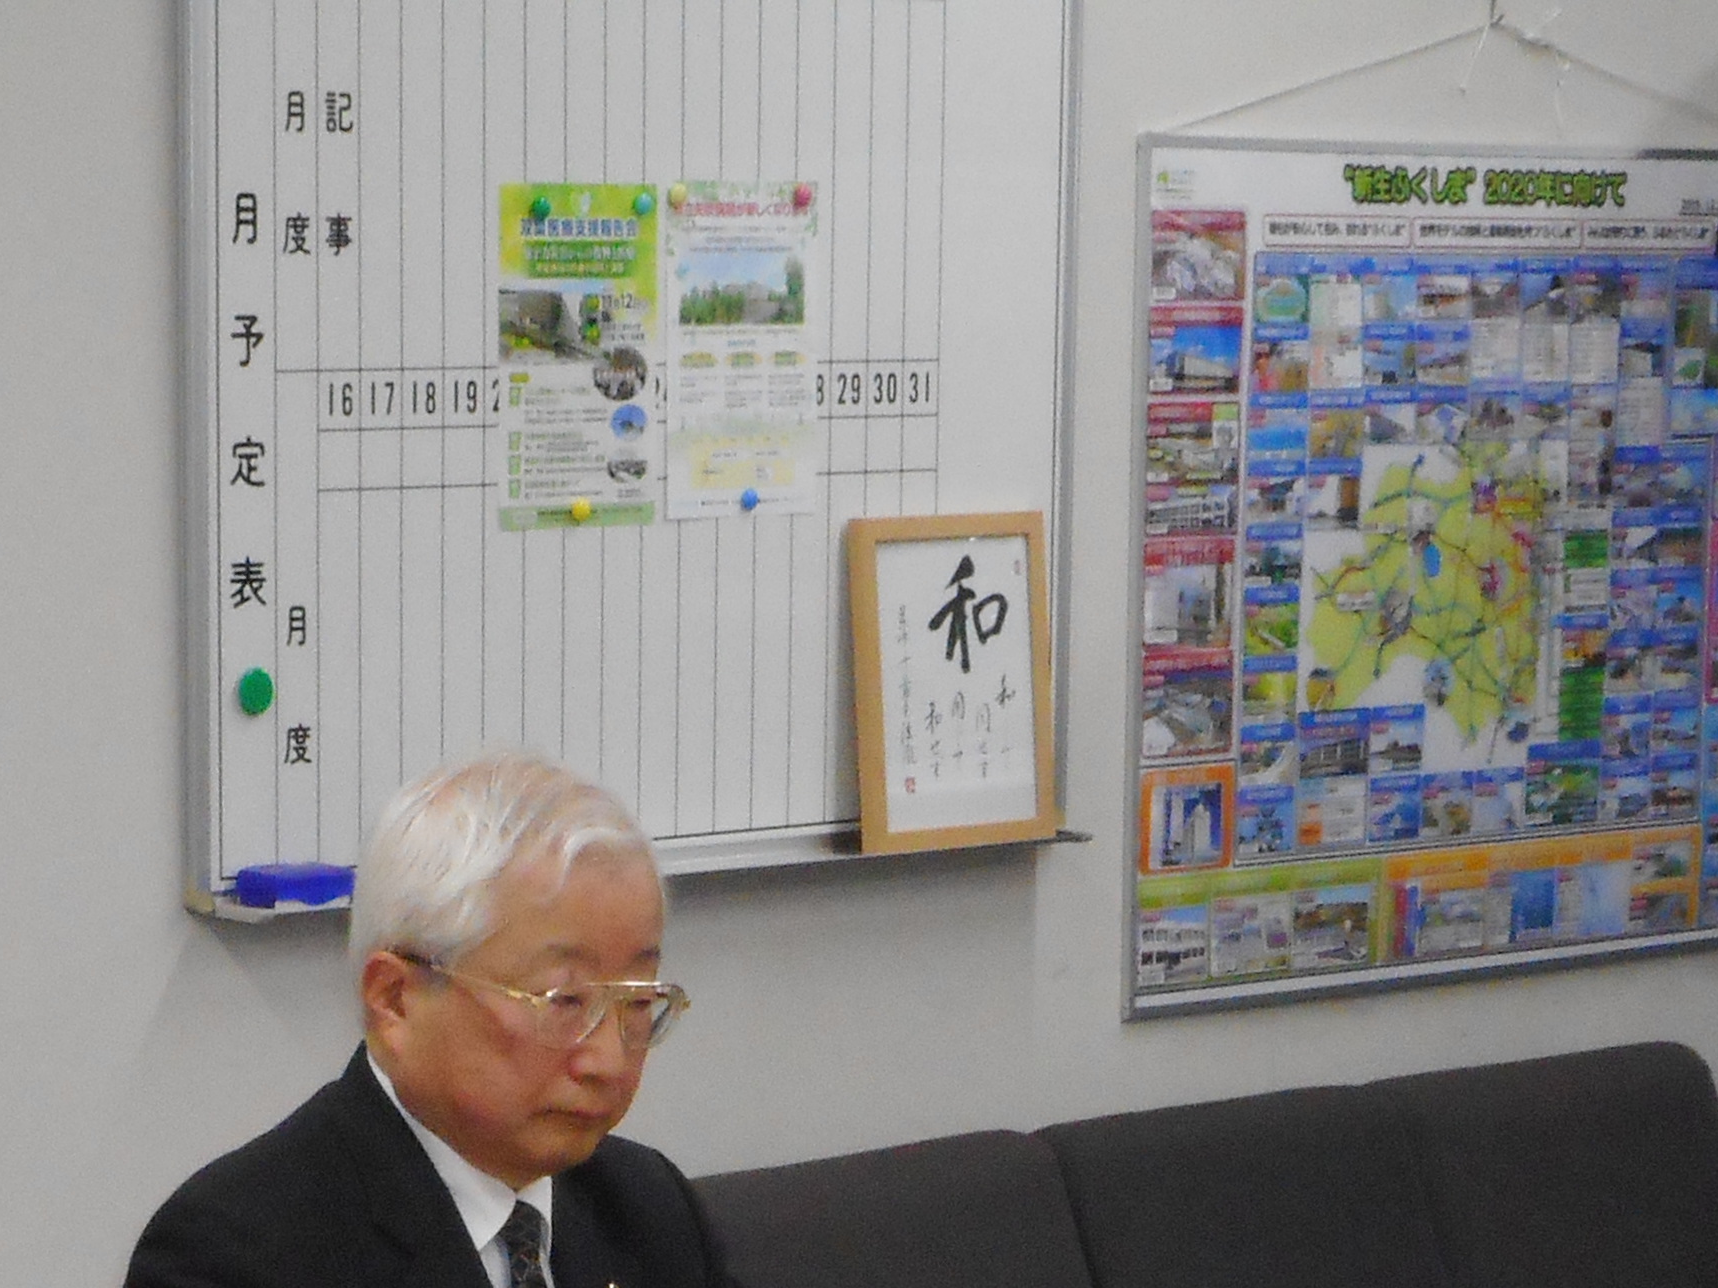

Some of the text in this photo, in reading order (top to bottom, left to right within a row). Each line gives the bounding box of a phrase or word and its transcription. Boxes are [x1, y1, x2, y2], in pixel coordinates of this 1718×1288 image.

[282, 90, 311, 255] 月度
[325, 91, 354, 256] 記事
[230, 192, 267, 609] 月予定表
[329, 383, 353, 416] 16
[371, 381, 394, 415] 17
[413, 381, 436, 414] 18
[454, 380, 477, 414] 19
[837, 372, 861, 405] 29
[873, 372, 897, 404] 30
[909, 371, 929, 403] 31
[284, 605, 312, 765] 月度
[928, 554, 1008, 674] 和
